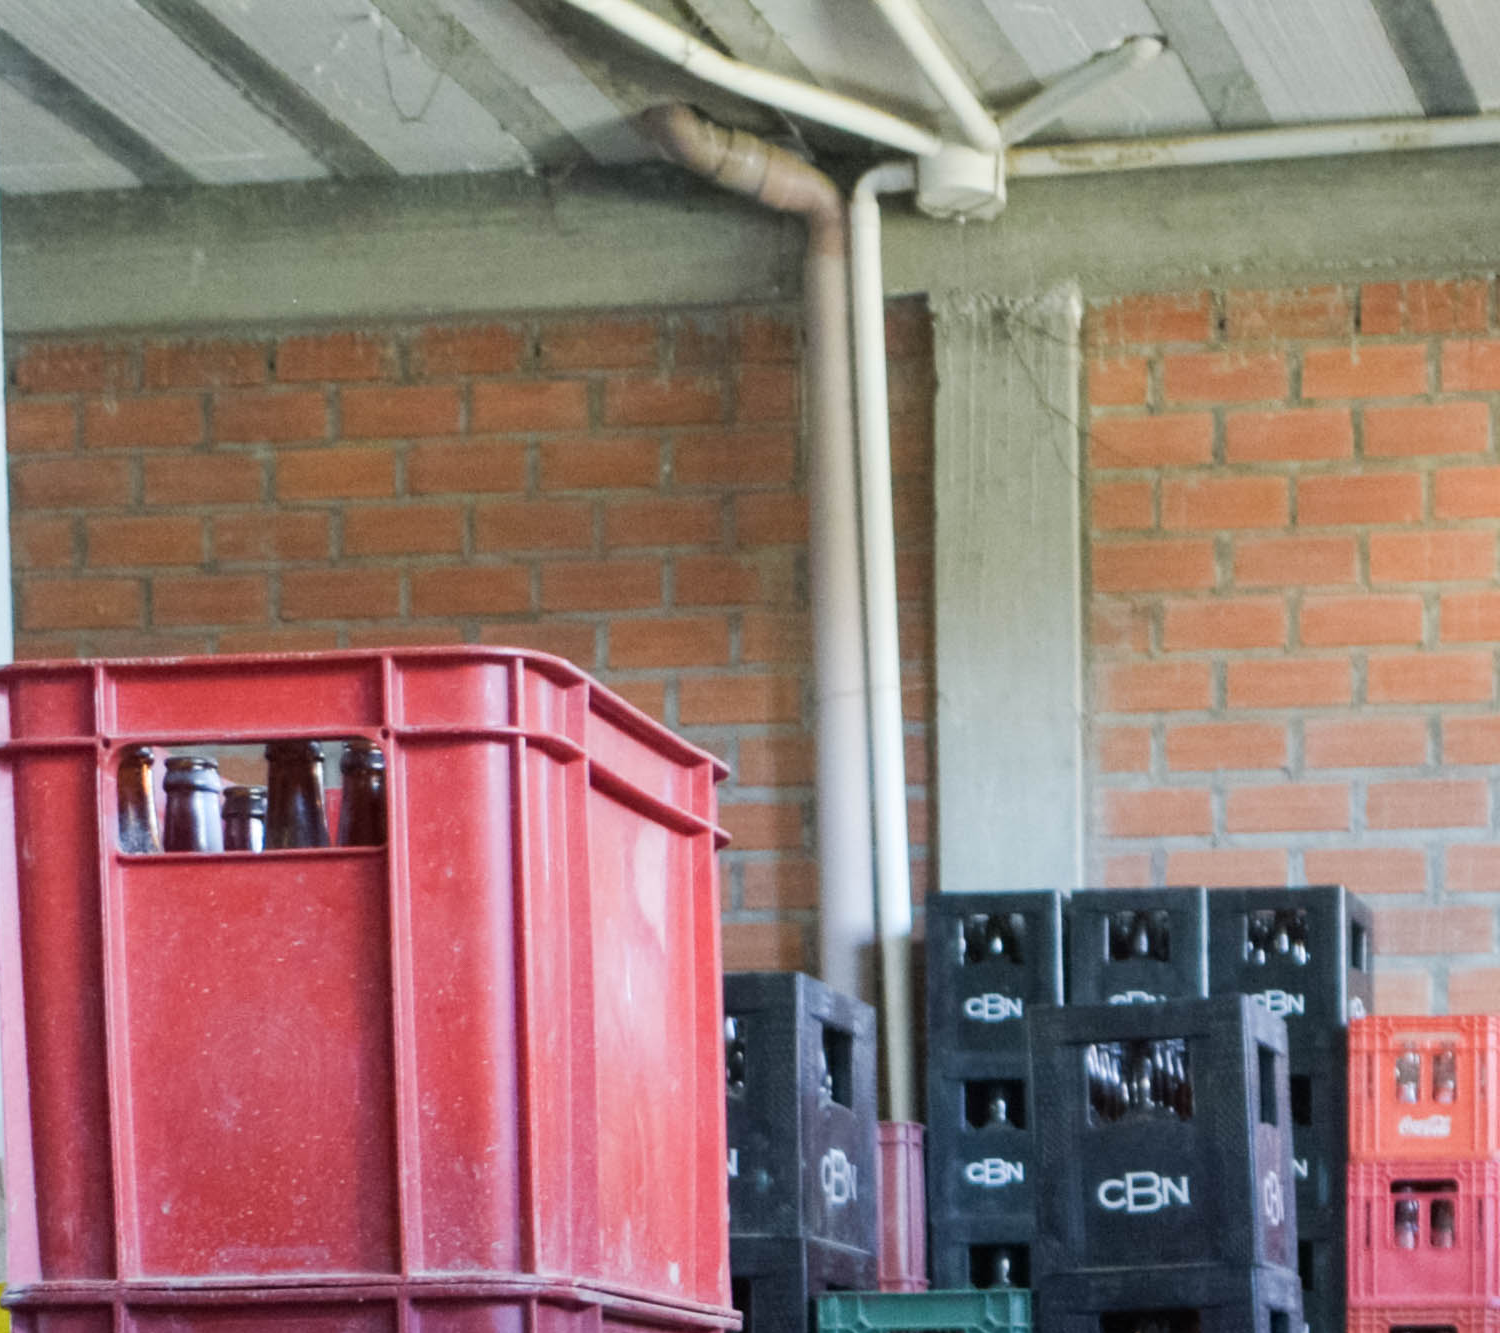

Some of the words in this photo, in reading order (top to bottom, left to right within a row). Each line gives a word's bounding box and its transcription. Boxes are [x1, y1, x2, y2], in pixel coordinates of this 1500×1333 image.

[964, 993, 1024, 1022] CBN
[966, 1157, 1025, 1187] CBN
[1097, 1170, 1191, 1213] CBN
